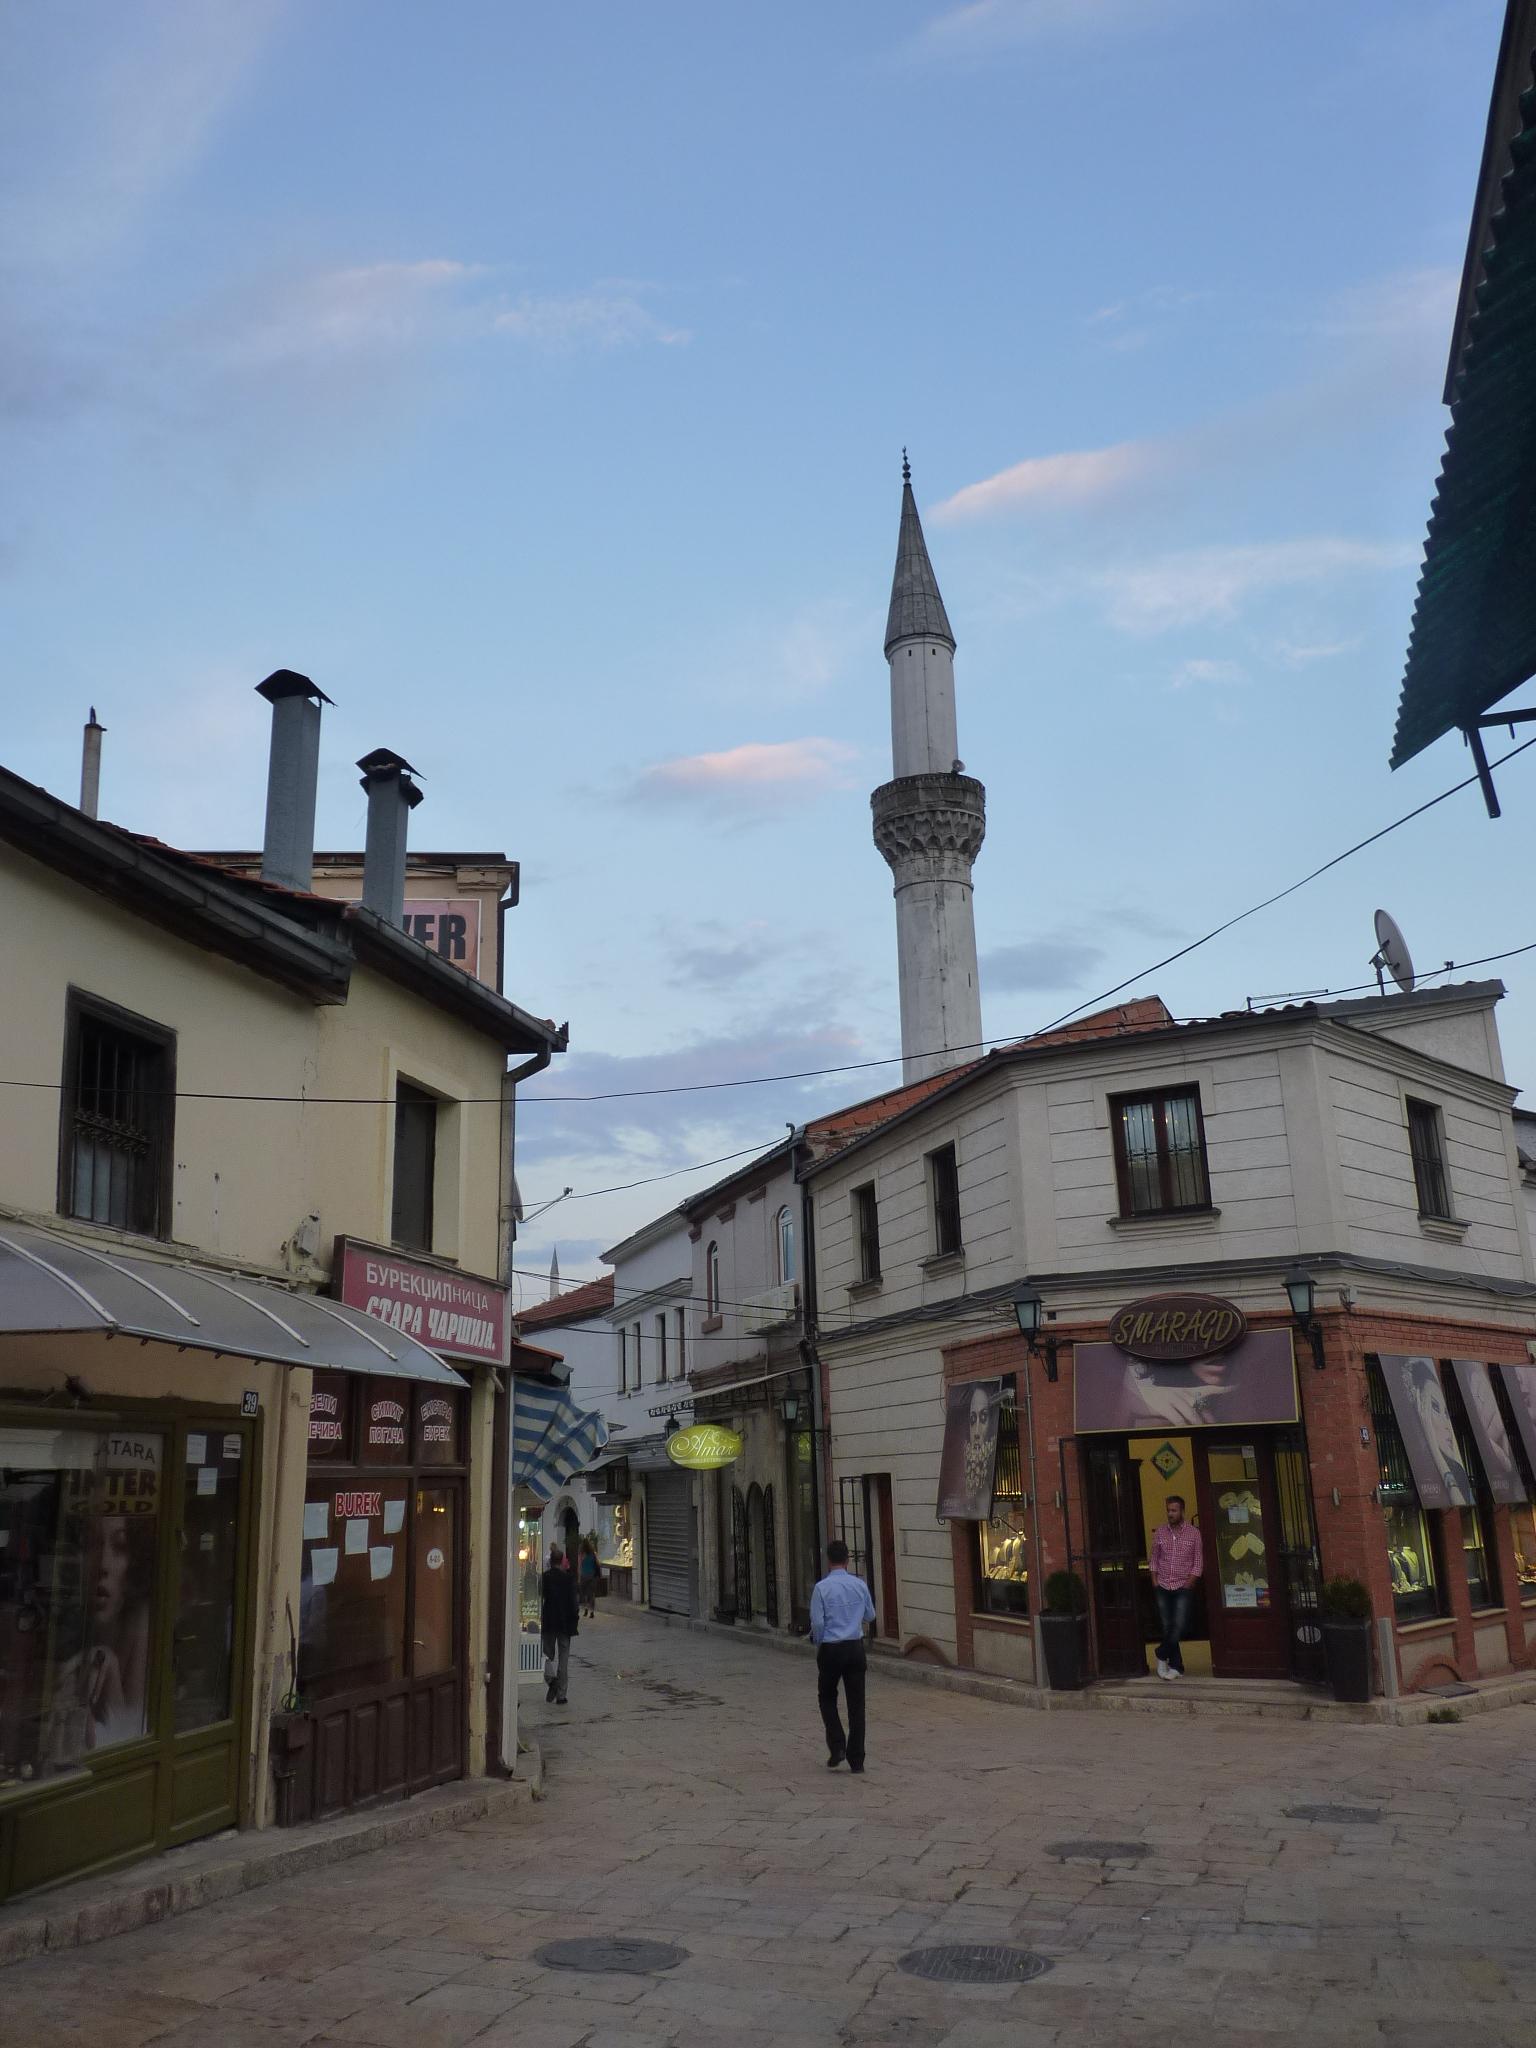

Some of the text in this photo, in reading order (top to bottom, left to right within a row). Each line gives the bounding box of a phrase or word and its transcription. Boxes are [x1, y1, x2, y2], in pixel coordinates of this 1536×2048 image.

[366, 1295, 423, 1334] СТАРА
[1115, 1309, 1233, 1350] SMARAGD
[244, 1393, 257, 1412] 39
[308, 1421, 343, 1440] ЕЧИВА
[369, 1426, 405, 1444] ПОГАЧА
[423, 1425, 450, 1441] БУРЕК
[335, 1492, 381, 1517] BUREK
